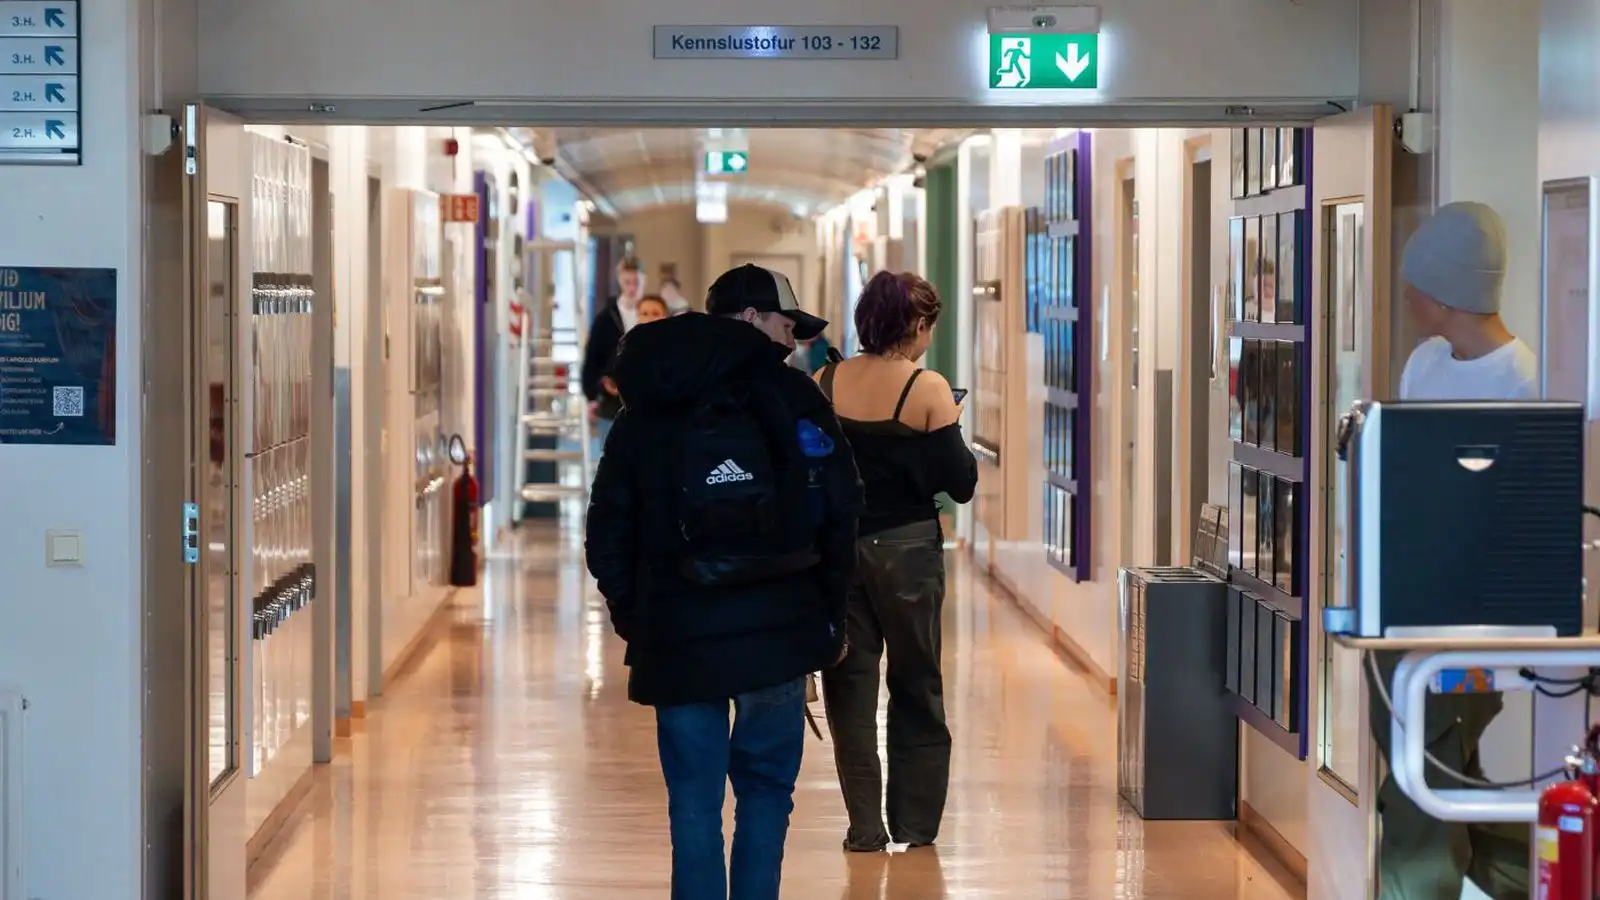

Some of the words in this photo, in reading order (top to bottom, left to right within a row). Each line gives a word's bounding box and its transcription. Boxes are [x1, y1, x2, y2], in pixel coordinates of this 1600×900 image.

[12, 16, 36, 27] 3.H.
[671, 34, 796, 51] Kennslustofur
[801, 35, 832, 50] 103
[850, 35, 881, 50] 132
[12, 54, 36, 64] 3.H.
[12, 91, 36, 102] 2.H.
[12, 128, 36, 138] 2.H.
[0, 313, 20, 332] IG!
[705, 472, 754, 485] adidas
